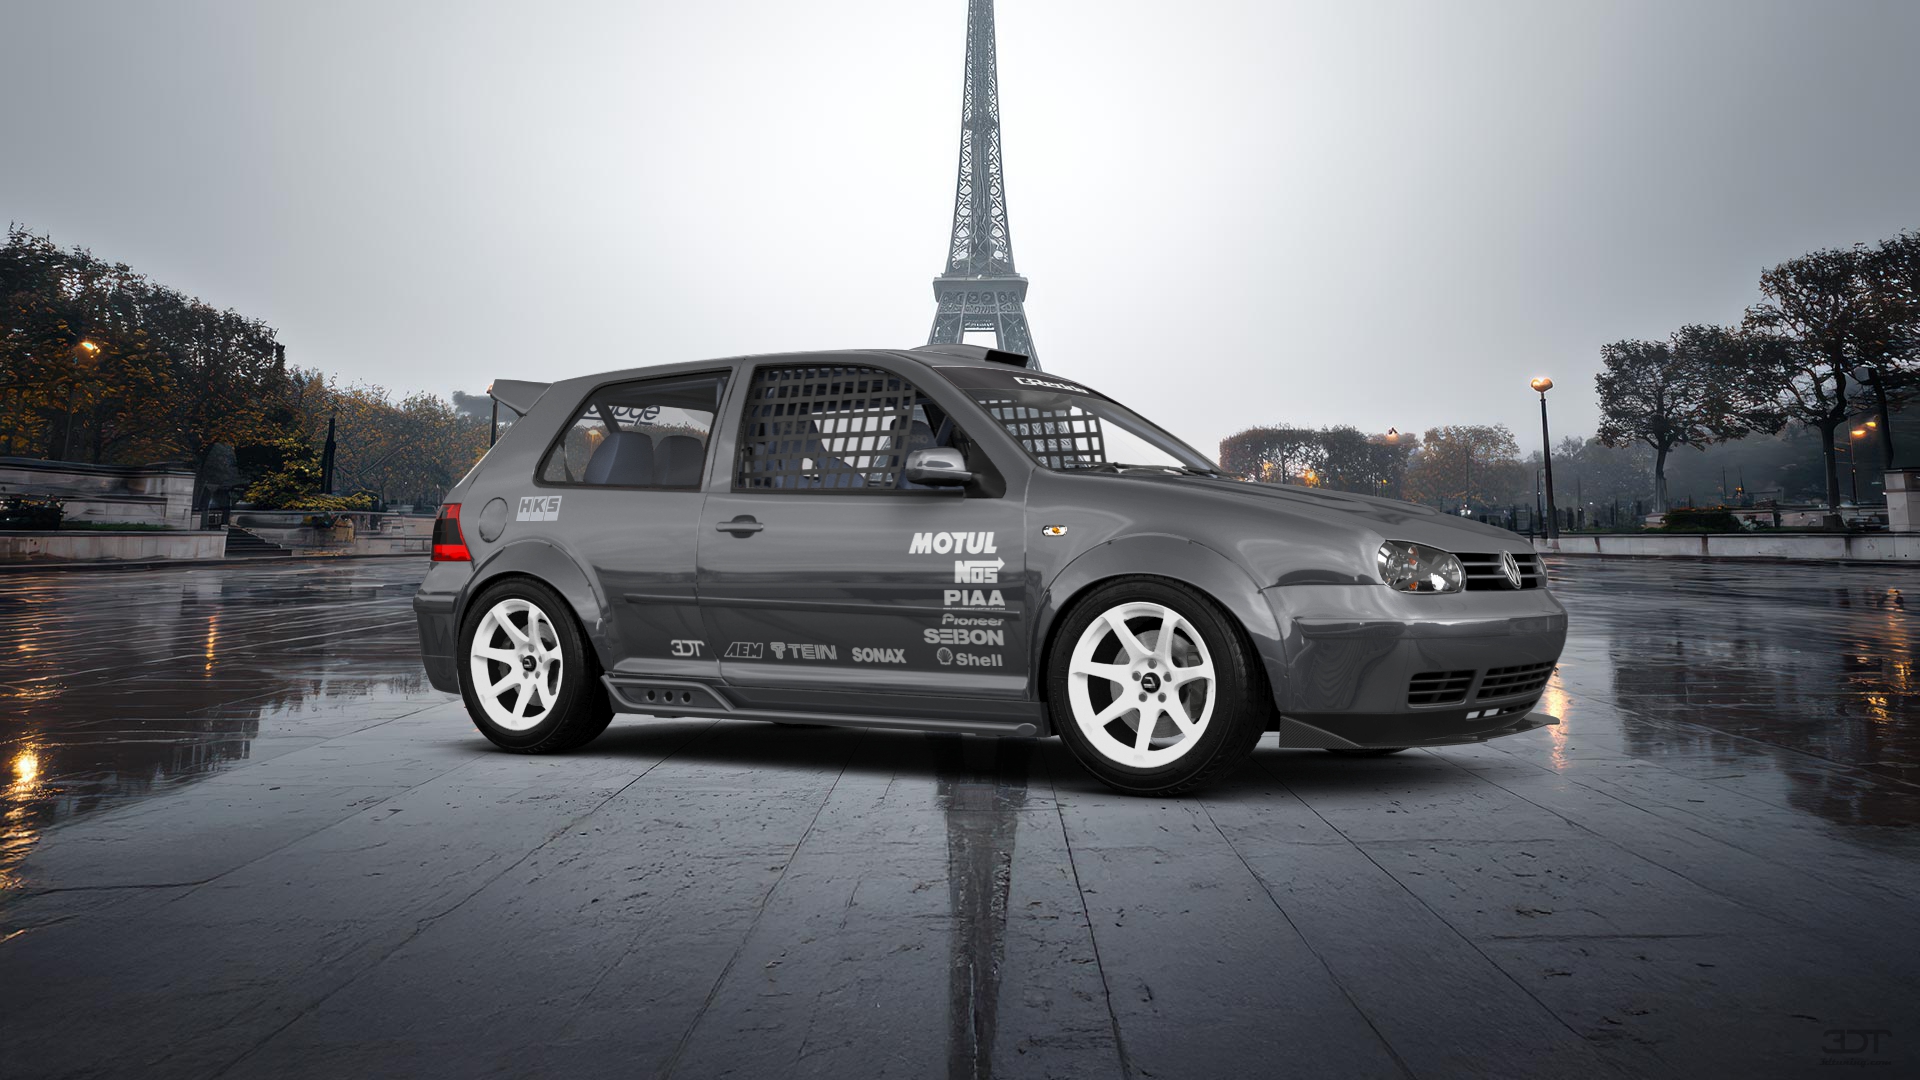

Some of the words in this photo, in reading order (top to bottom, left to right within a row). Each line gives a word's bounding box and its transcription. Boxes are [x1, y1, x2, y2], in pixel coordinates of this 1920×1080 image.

[518, 497, 561, 516] HKS
[909, 532, 997, 554] MOTUL
[955, 558, 1003, 584] NOS
[944, 590, 1005, 606] PIAA
[942, 613, 1004, 626] Pioneer
[923, 628, 1004, 646] SEBON
[671, 639, 705, 657] 3DT
[724, 641, 764, 659] AEM
[787, 643, 837, 660] TEIN
[852, 647, 907, 663] SONAX
[956, 653, 1003, 667] Shell
